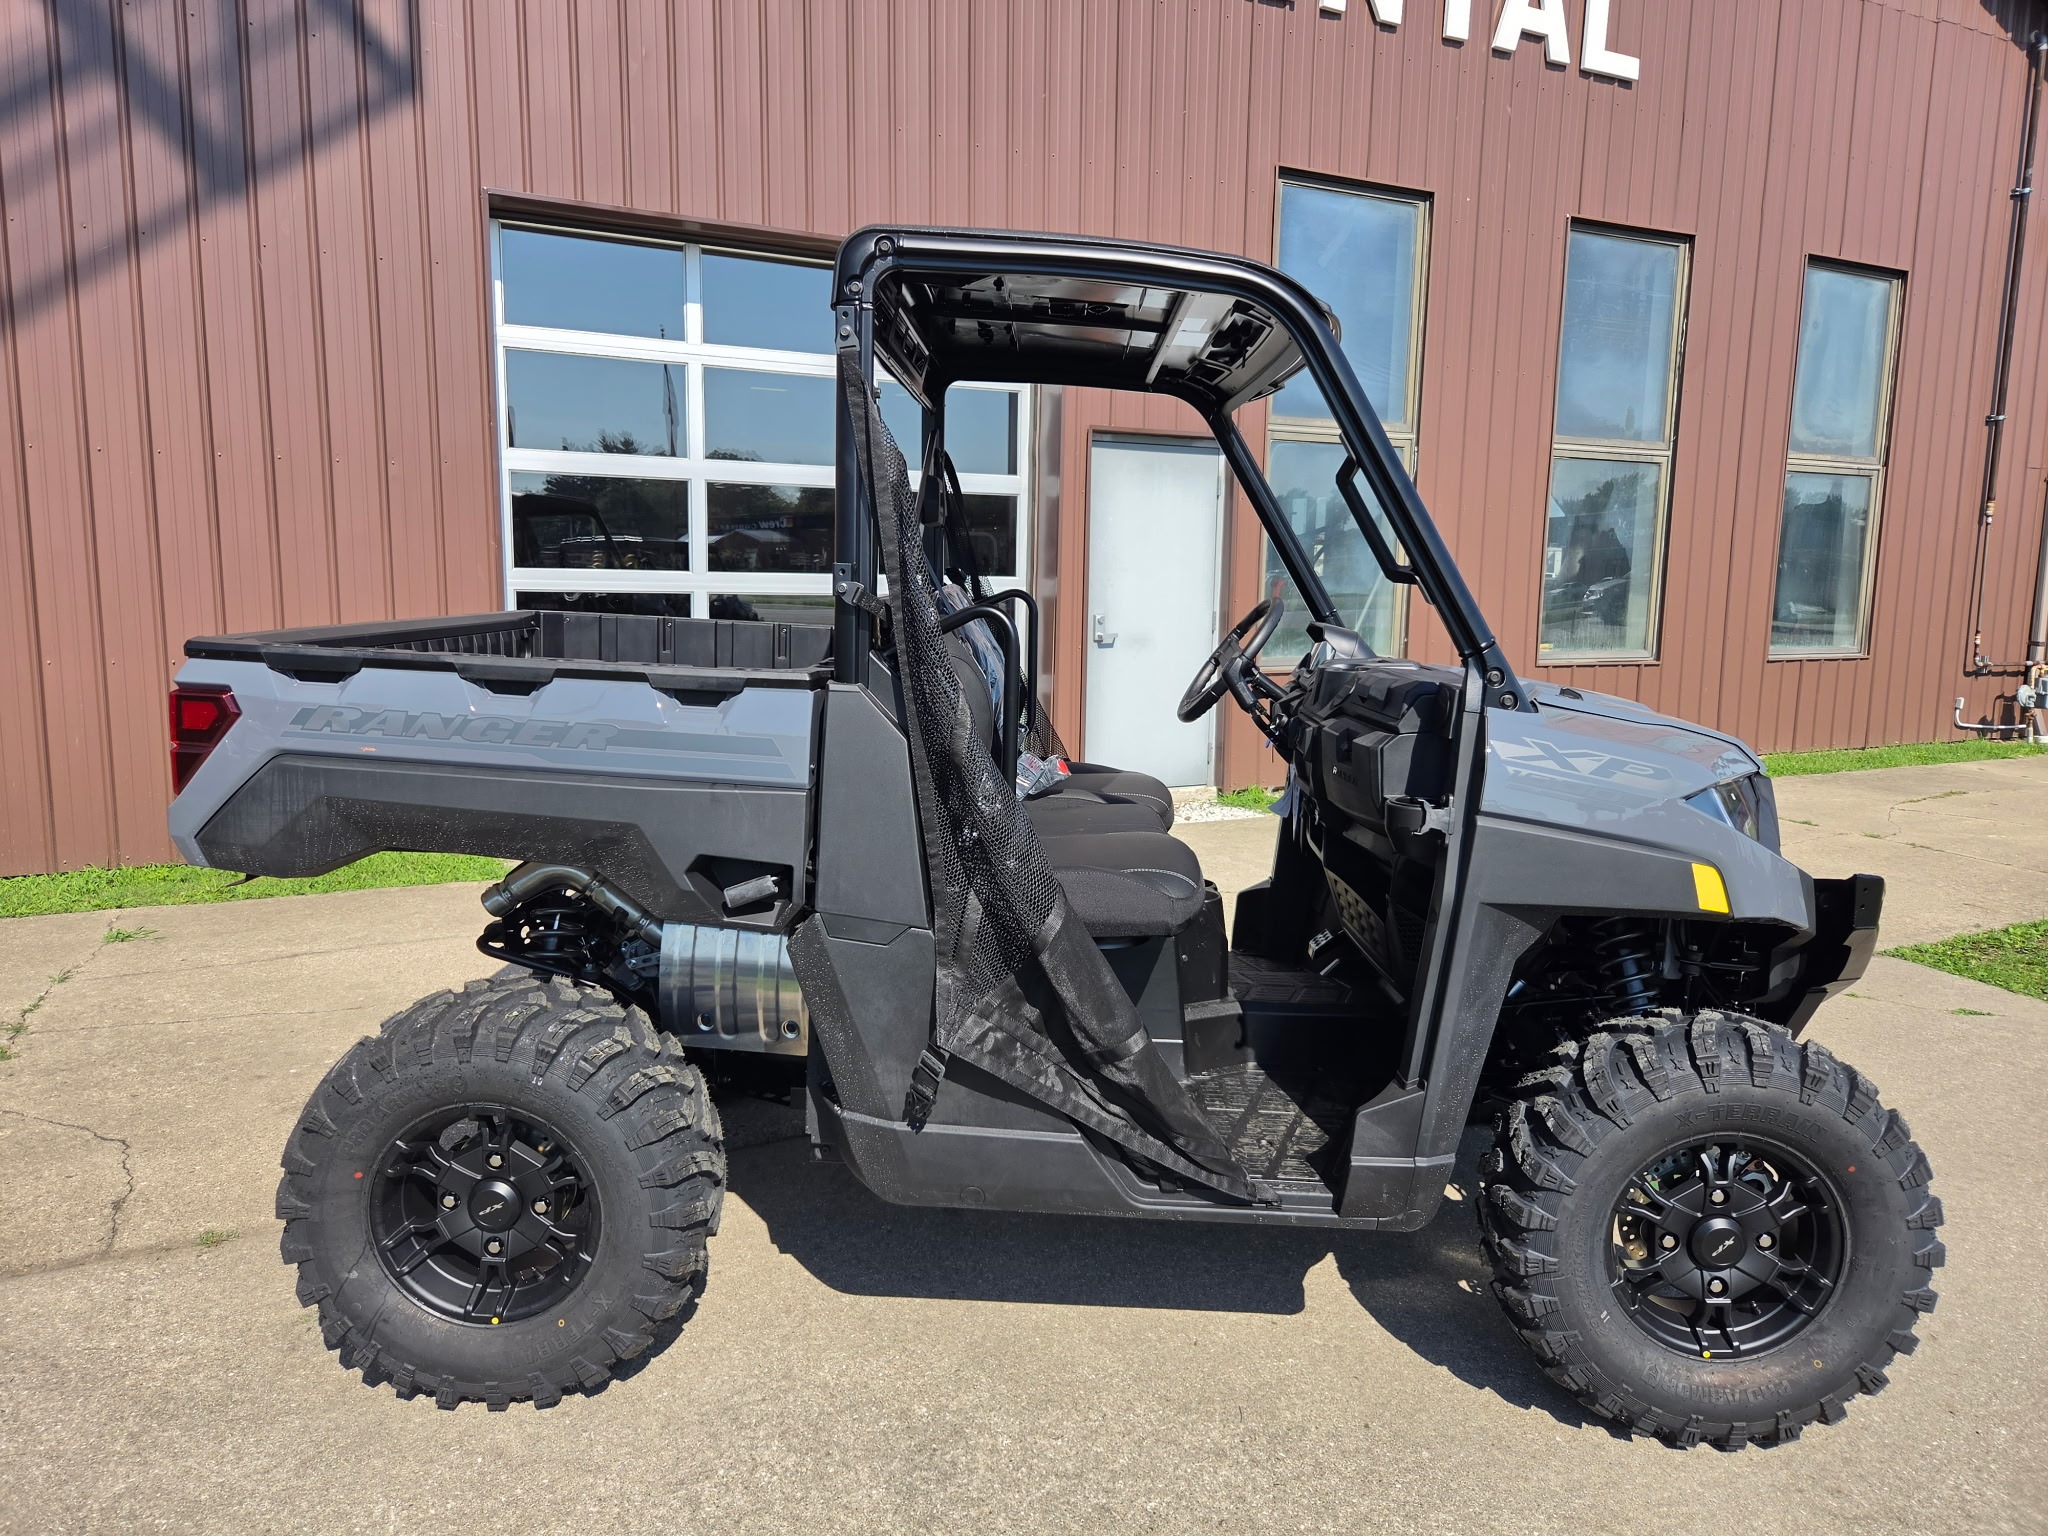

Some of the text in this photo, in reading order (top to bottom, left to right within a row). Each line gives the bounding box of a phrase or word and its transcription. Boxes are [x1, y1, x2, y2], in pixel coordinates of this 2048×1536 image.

[301, 704, 619, 750] RANGER
[1500, 737, 1674, 781] XP
[1674, 1102, 1829, 1143] X-TERRAIN
[1711, 1235, 1736, 1257] XP
